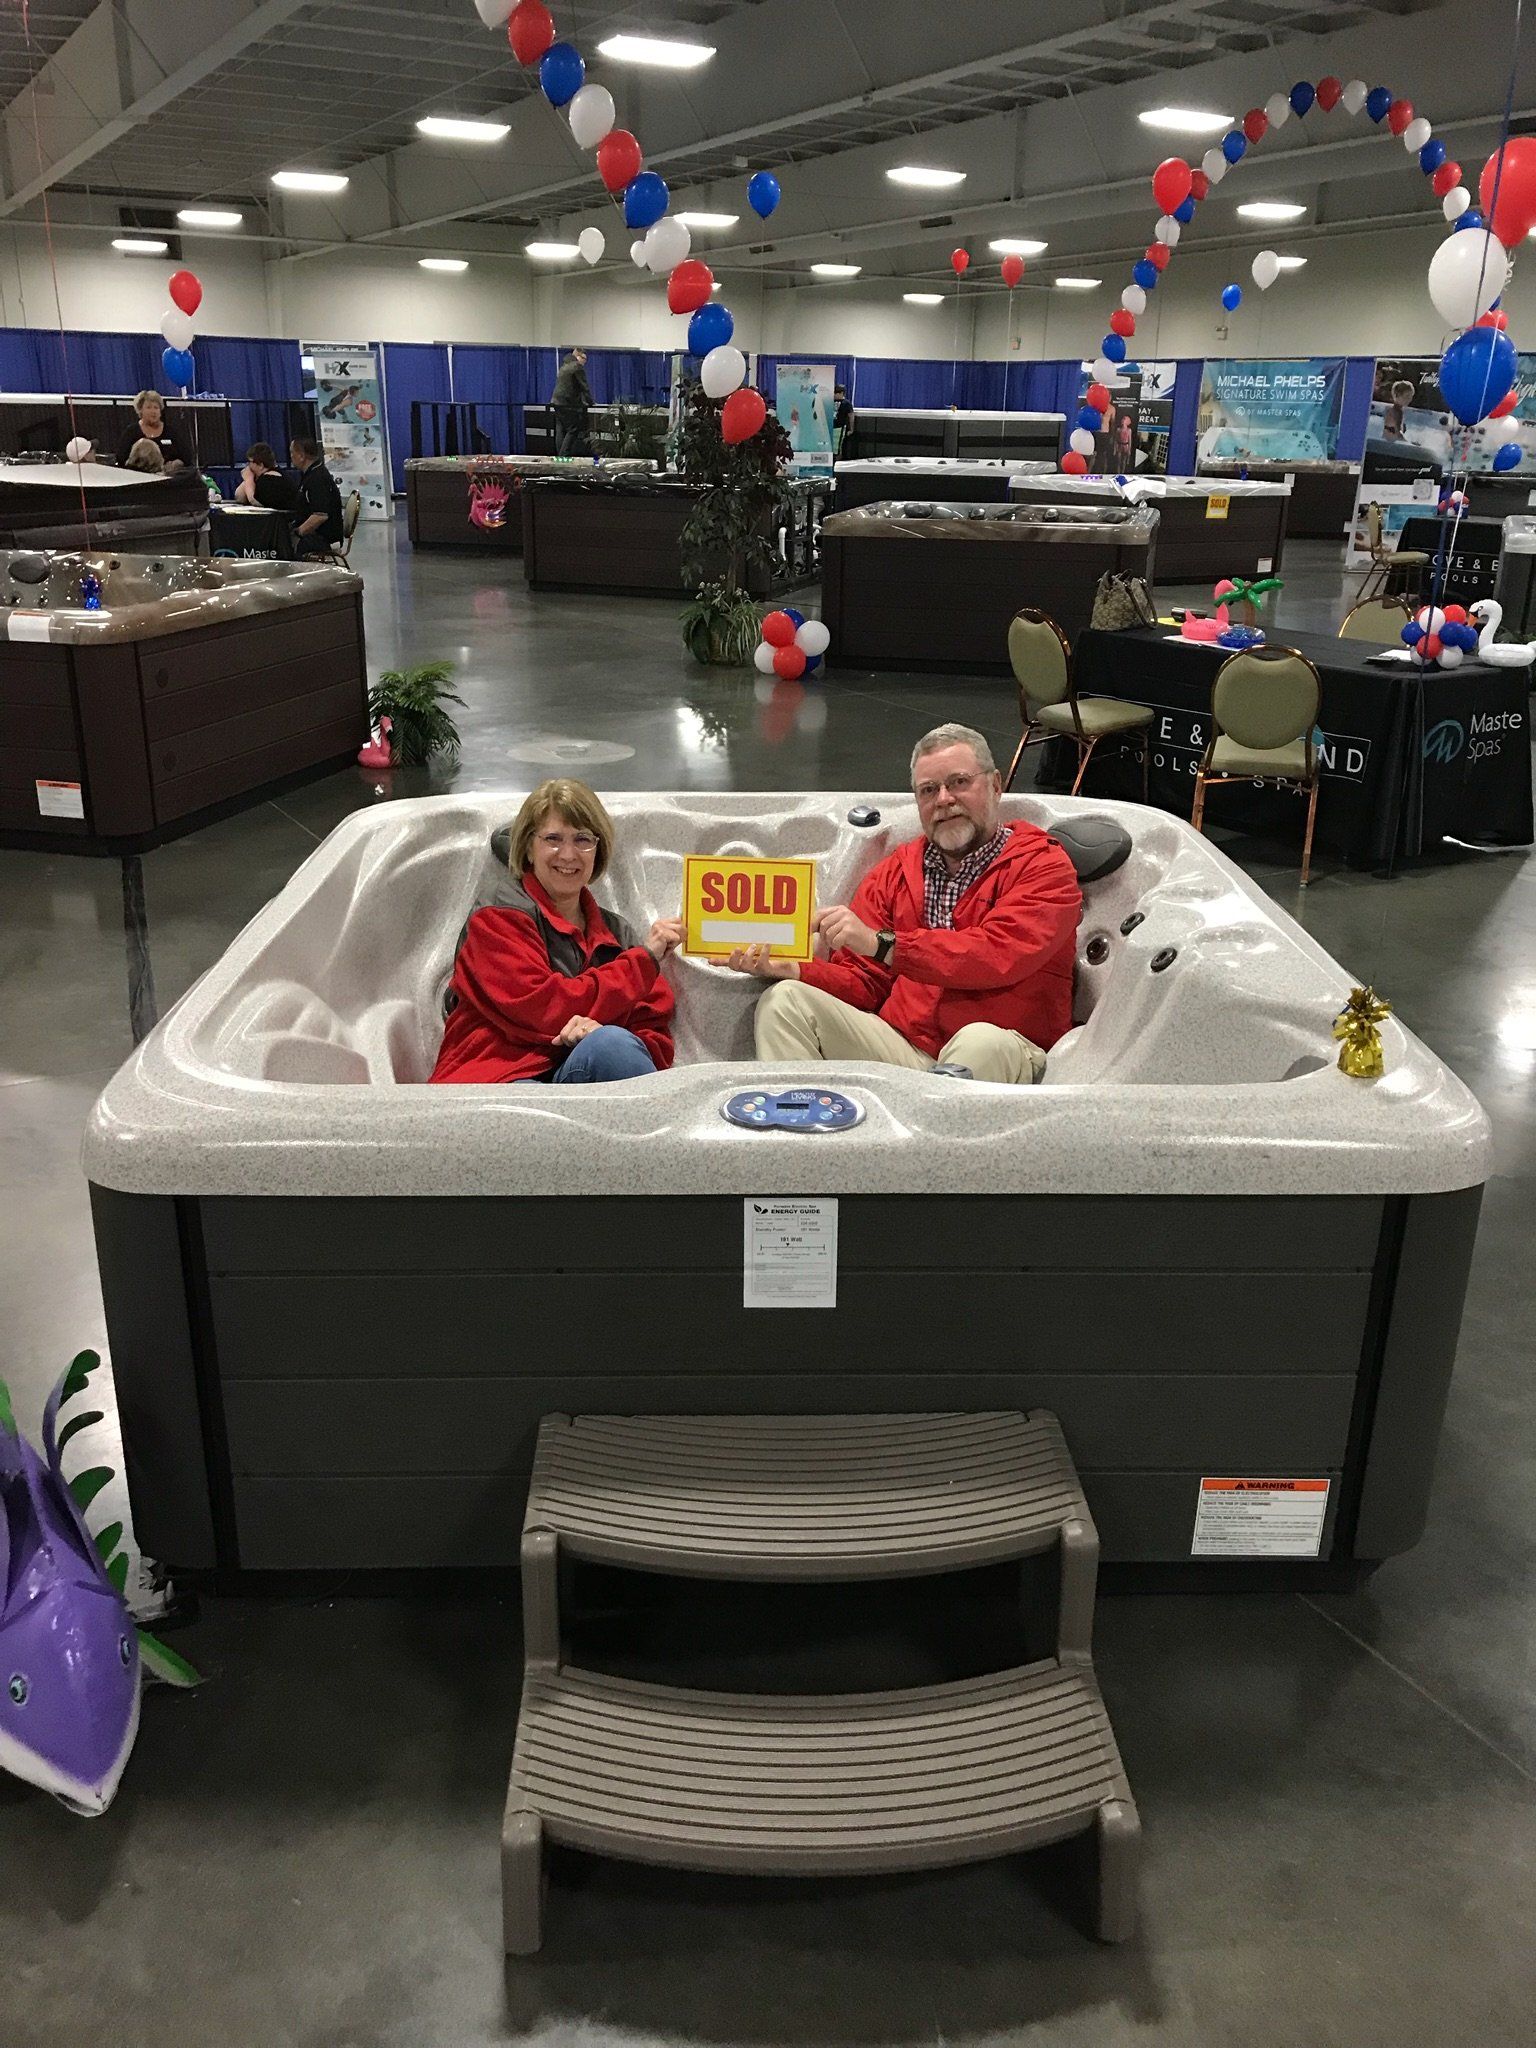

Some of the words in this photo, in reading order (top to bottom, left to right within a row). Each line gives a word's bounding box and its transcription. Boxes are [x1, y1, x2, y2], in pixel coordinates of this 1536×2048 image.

[1217, 375, 1271, 387] MICHAEL
[1274, 375, 1326, 387] PHELPS
[1216, 389, 1267, 400] SIGNATURE
[1270, 390, 1297, 400] SWIM
[1300, 390, 1324, 401] SPAS
[1210, 498, 1227, 508] SOLD
[1190, 724, 1203, 745] &
[1318, 744, 1363, 773] ND
[1467, 738, 1501, 764] Spas
[1253, 774, 1303, 797] SPA
[701, 871, 797, 915] SOLD
[1246, 1482, 1295, 1490] WARNING
